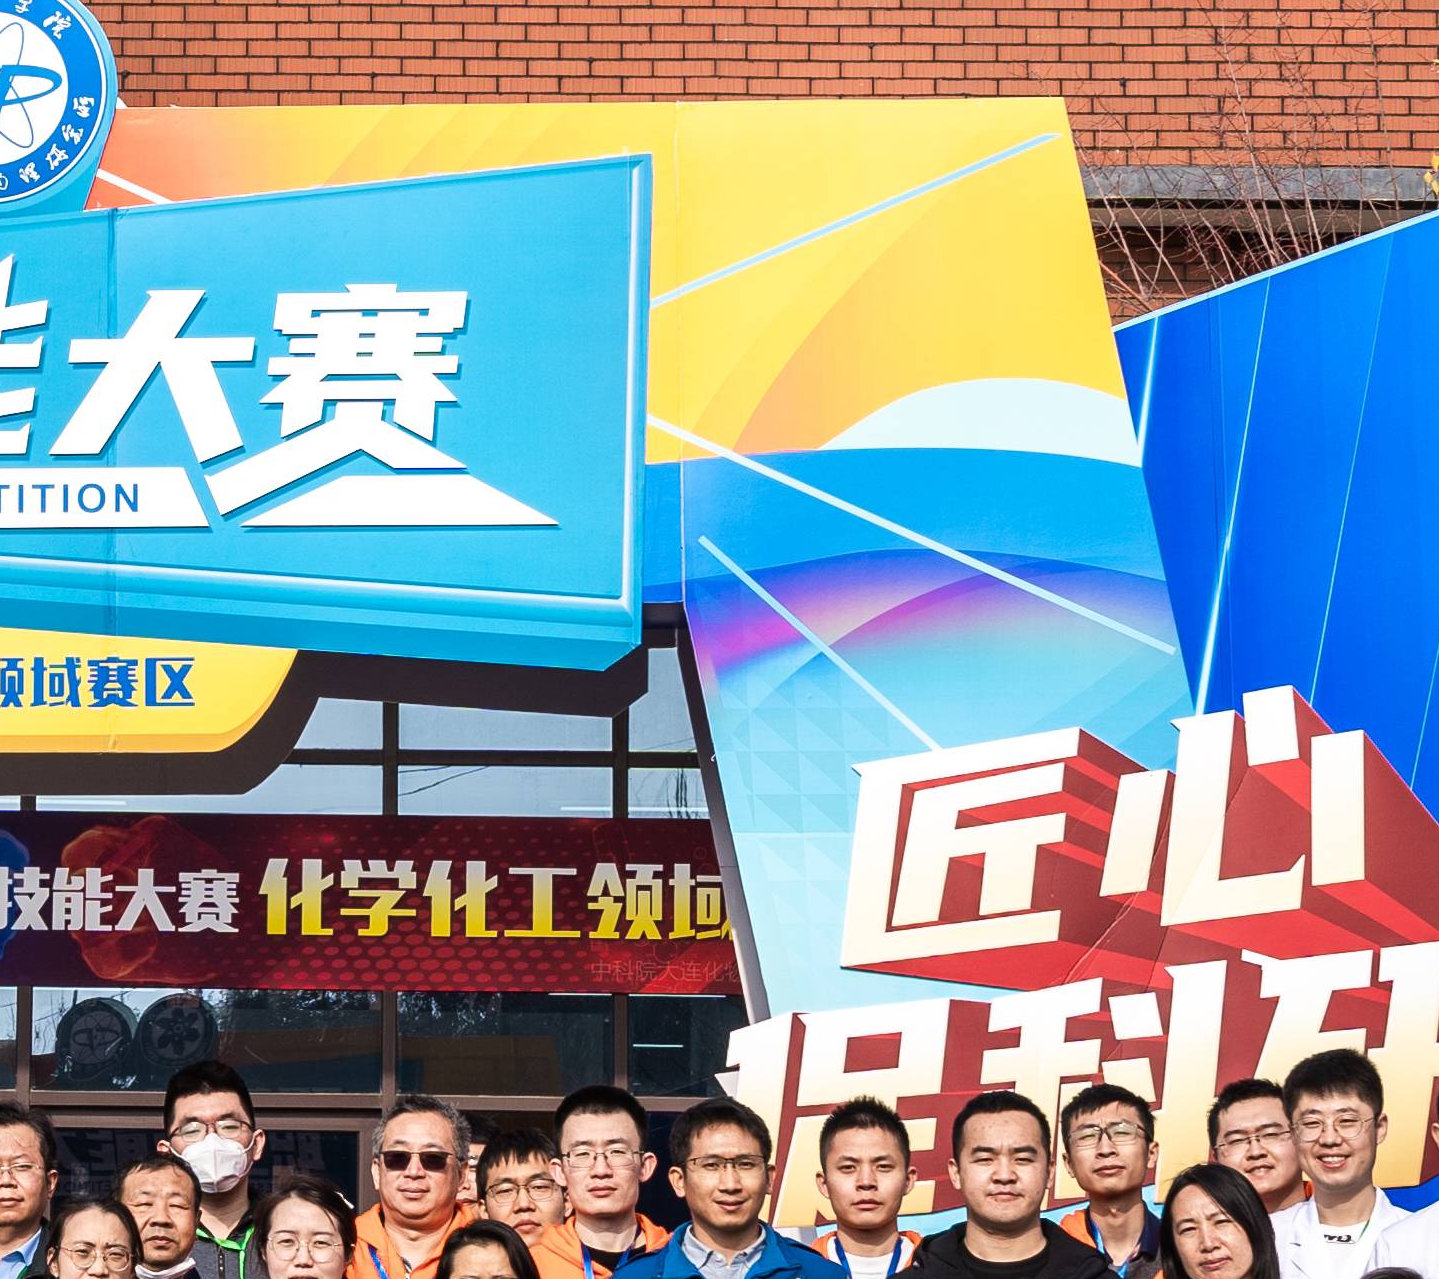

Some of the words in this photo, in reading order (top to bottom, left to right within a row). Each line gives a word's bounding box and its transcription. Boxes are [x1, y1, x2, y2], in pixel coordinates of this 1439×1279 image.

[258, 857, 735, 941] 化学化工领域
[841, 684, 1366, 969] 匠心
